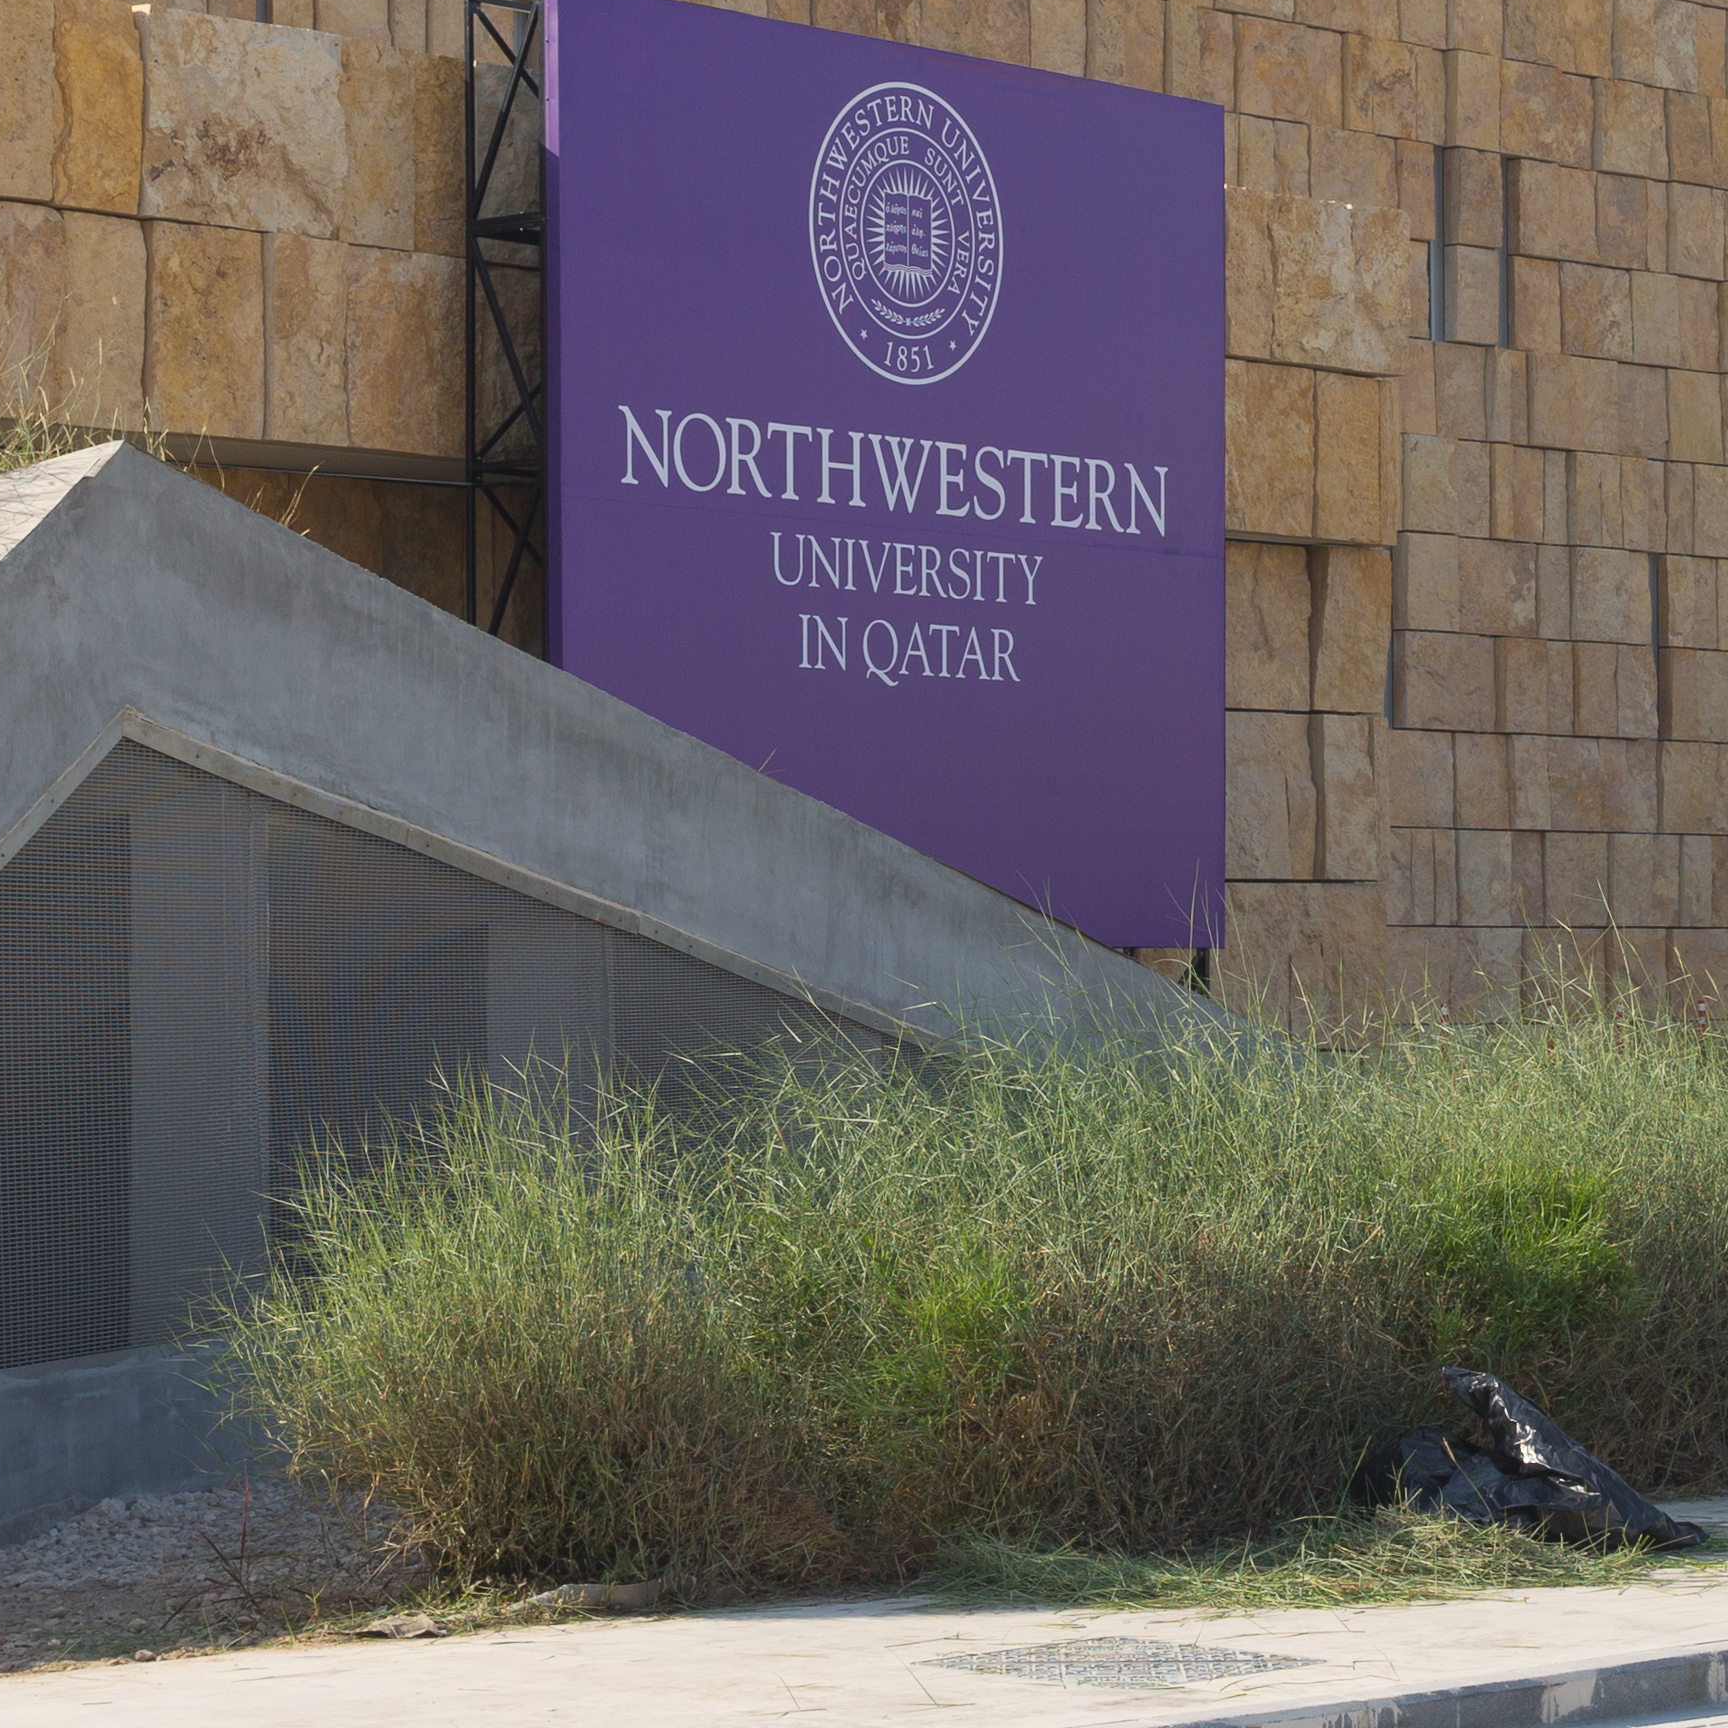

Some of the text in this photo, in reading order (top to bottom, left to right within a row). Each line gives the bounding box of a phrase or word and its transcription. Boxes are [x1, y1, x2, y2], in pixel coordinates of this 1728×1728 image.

[817, 95, 996, 336] NORTHWESTERN UNIVERSITY
[843, 136, 971, 295] QUAECUMQUE SUNT VERA
[883, 341, 934, 373] 1851
[617, 404, 1169, 538] NORTHWESTERN
[770, 531, 1044, 606] UNIVERSITY
[798, 613, 1022, 687] IN QATAR
